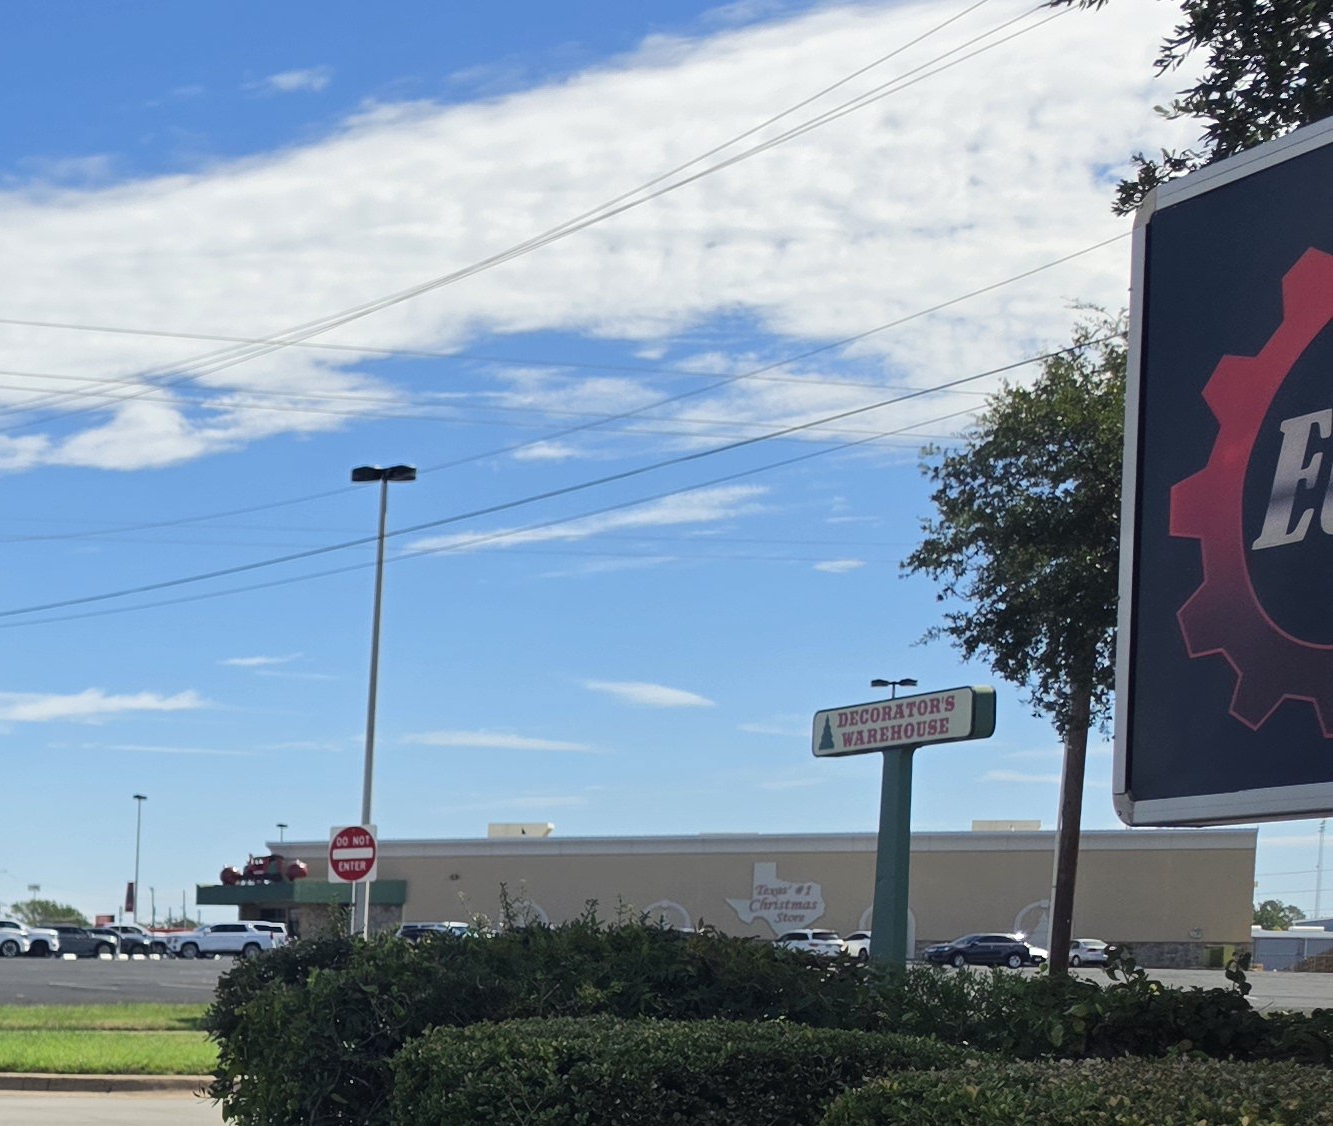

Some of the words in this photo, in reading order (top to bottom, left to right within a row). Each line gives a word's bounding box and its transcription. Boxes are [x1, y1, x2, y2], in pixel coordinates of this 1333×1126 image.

[1252, 409, 1333, 550] E
[837, 695, 956, 728] DECORATOR'S
[842, 717, 950, 748] WAREHOUSE
[336, 836, 348, 847] DO
[353, 835, 370, 846] NOT
[338, 860, 366, 872] ENTER
[755, 884, 792, 897] Texas'
[795, 885, 813, 896] #1
[748, 897, 818, 913] Christmas
[774, 912, 806, 924] Store
